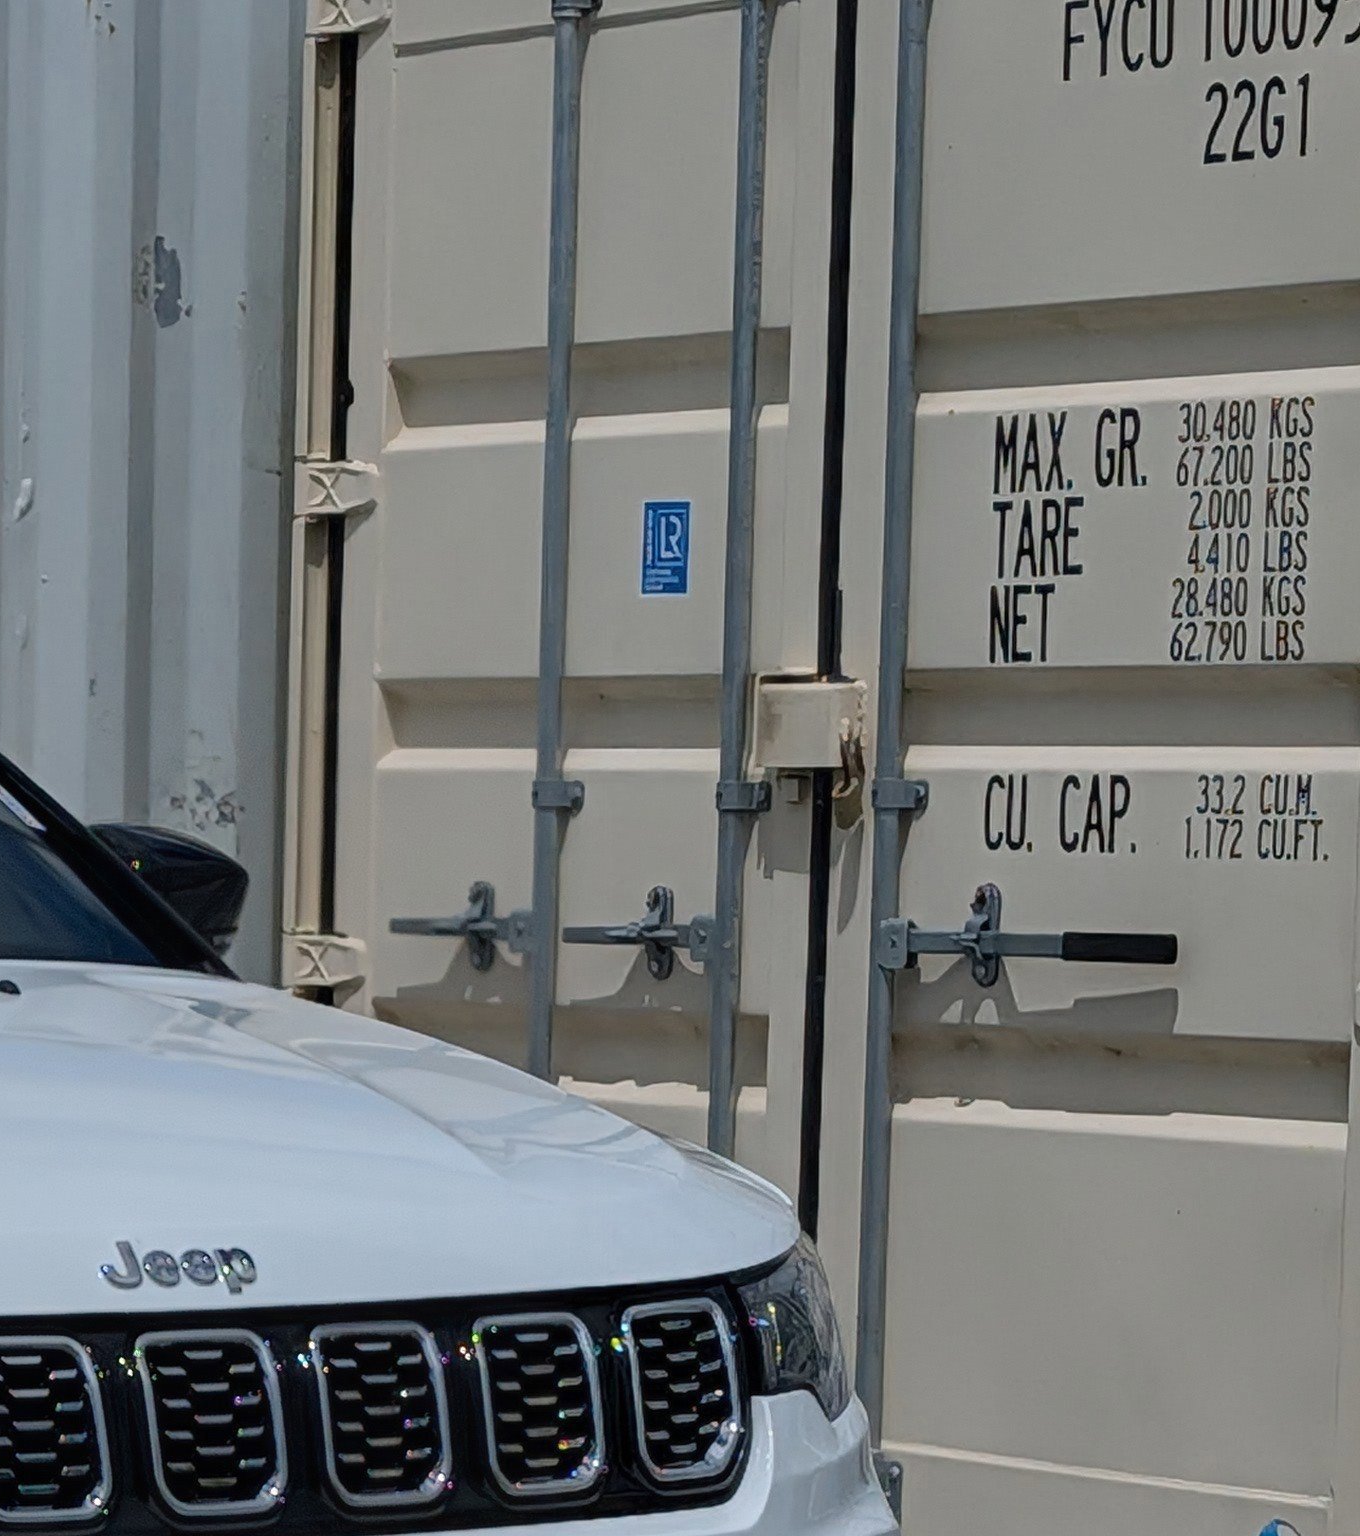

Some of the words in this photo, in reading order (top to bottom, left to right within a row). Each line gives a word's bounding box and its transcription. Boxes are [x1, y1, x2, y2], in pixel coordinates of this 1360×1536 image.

[1062, 0, 1176, 81] FYCU
[1203, 73, 1310, 164] 22G1
[1269, 396, 1316, 439] KGS
[993, 411, 1074, 494] MAX.
[1095, 407, 1147, 487] GR.
[1267, 441, 1312, 484] LBS
[1265, 486, 1310, 528] KGS
[992, 497, 1084, 579] TARE
[1263, 531, 1308, 572] LBS
[1261, 575, 1306, 617] KGS
[989, 584, 1055, 663] NET
[1260, 619, 1305, 661] LBS
[984, 774, 1033, 853] CU.
[1059, 774, 1136, 853] CAP.
[1257, 818, 1330, 862] CU.FT.
[99, 1240, 257, 1294] Jeep
